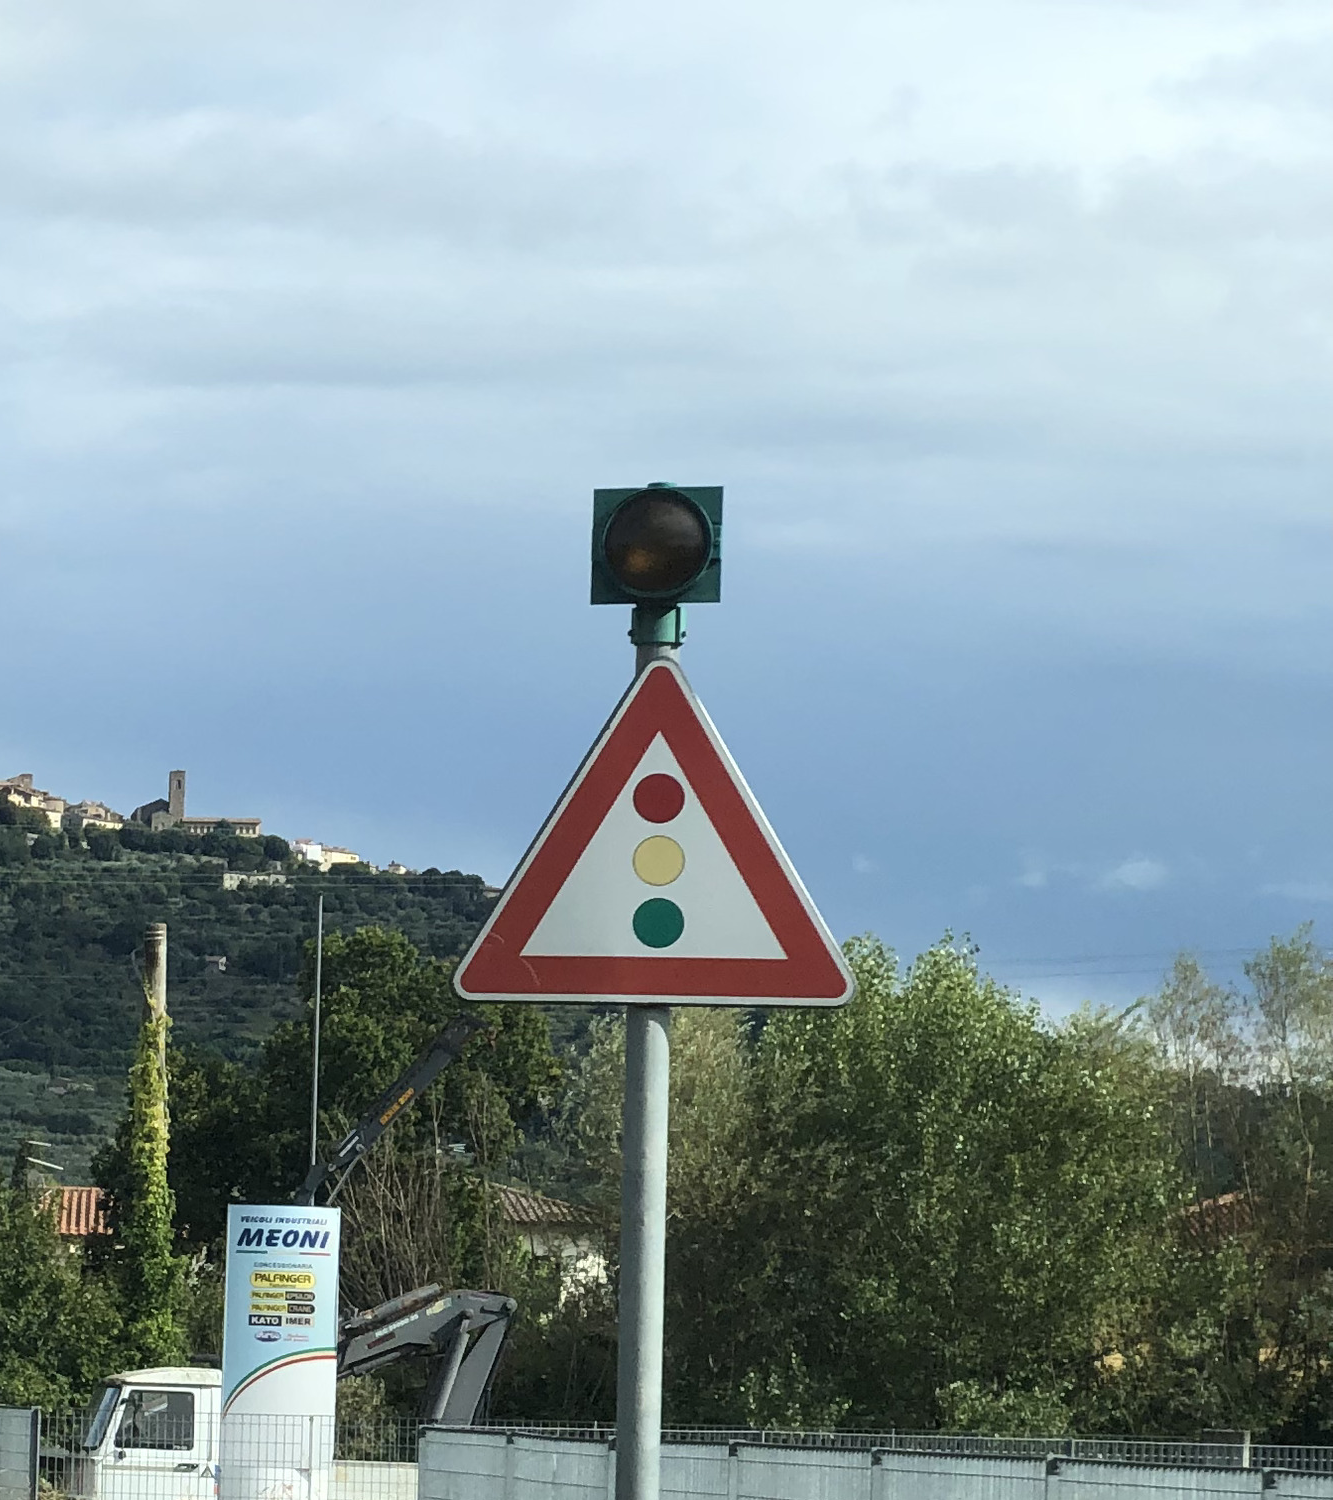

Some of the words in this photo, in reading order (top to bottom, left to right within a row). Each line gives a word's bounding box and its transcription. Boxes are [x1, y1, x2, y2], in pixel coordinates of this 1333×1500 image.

[275, 1217, 327, 1225] INDUSTRIALI
[237, 1228, 330, 1249] MEONI
[254, 1273, 311, 1284] PALFINGER
[251, 1316, 279, 1325] KATO
[285, 1317, 311, 1325] IMER
